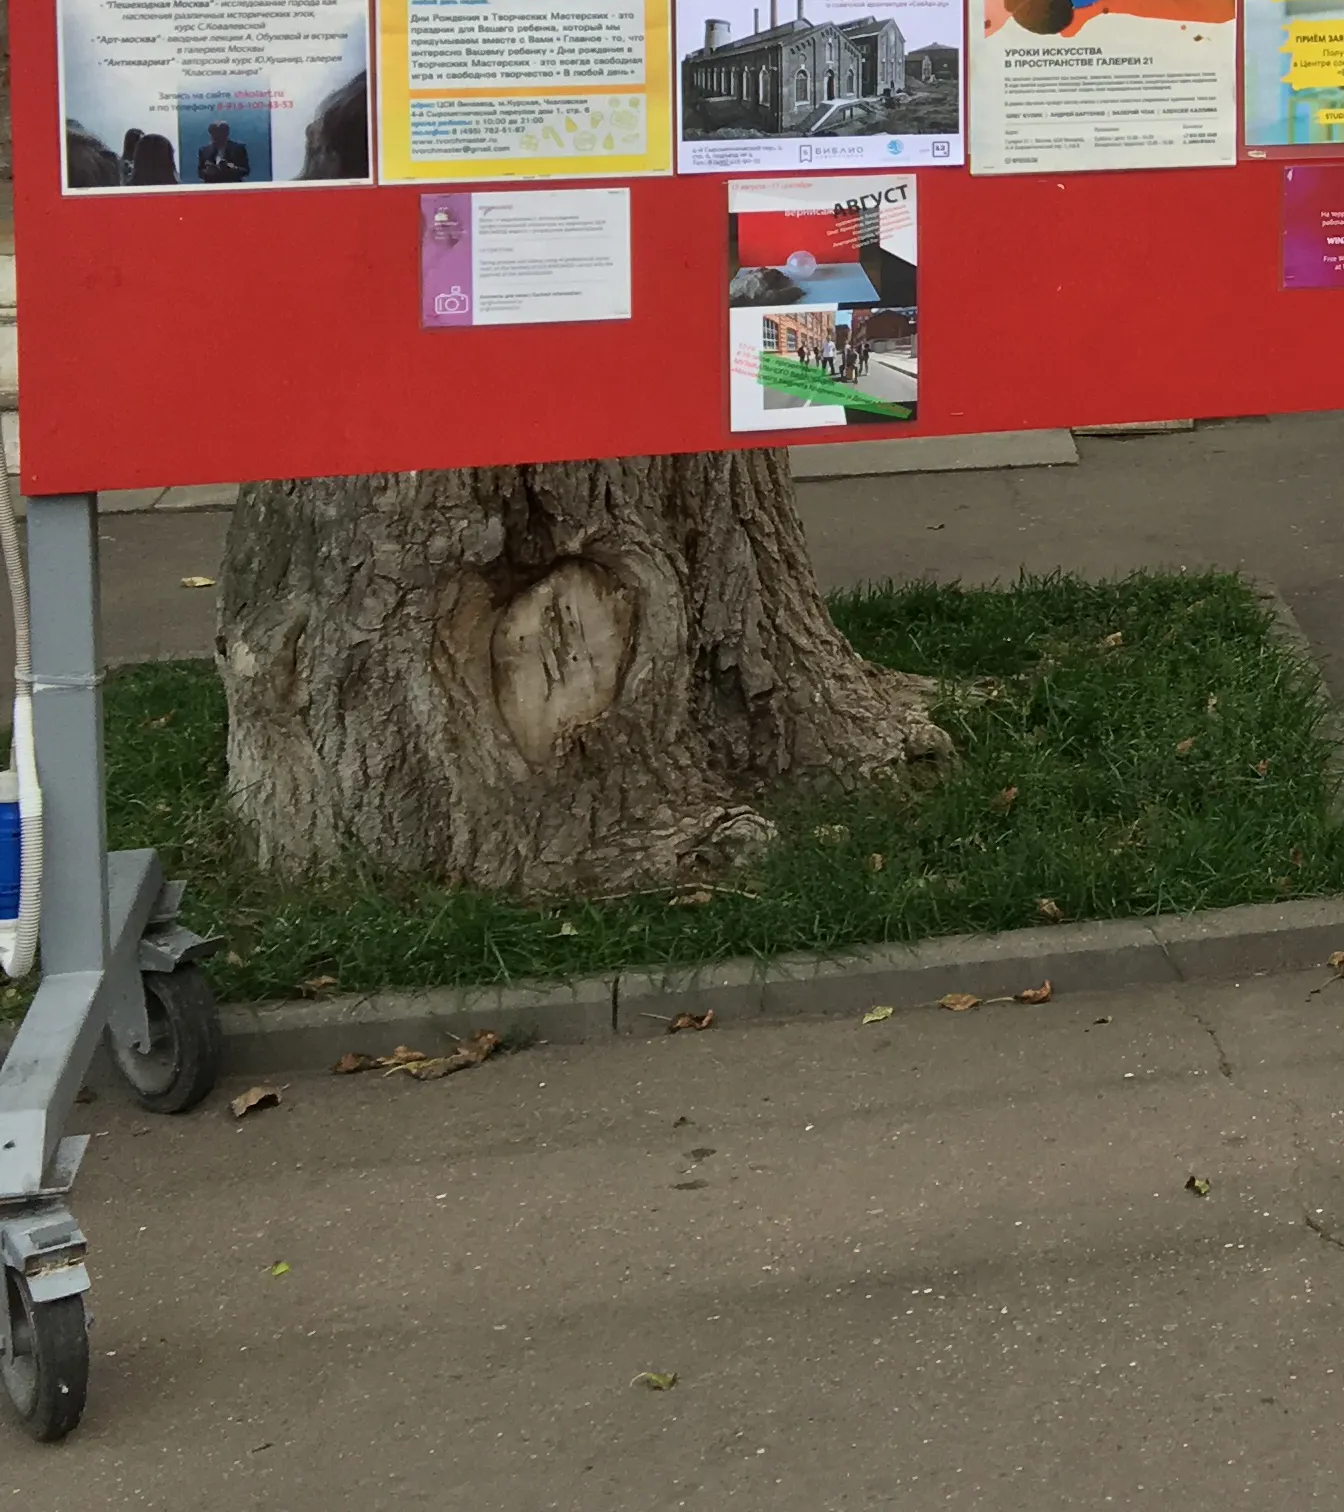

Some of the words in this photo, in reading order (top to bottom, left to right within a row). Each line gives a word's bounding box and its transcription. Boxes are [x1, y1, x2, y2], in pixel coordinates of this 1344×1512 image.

[1295, 33, 1326, 44] ПРИЁМ
[1004, 48, 1040, 57] УРОКИ
[1042, 47, 1102, 57] ИСКУССТВА
[1005, 59, 1012, 68] В
[1014, 57, 1094, 68] ПРОСТРАНСТВЕ
[1096, 57, 1141, 67] ГАЛЕРЕИ
[1143, 56, 1153, 66] 21
[1300, 59, 1331, 69] Центре
[833, 184, 908, 219] АВГУСТ
